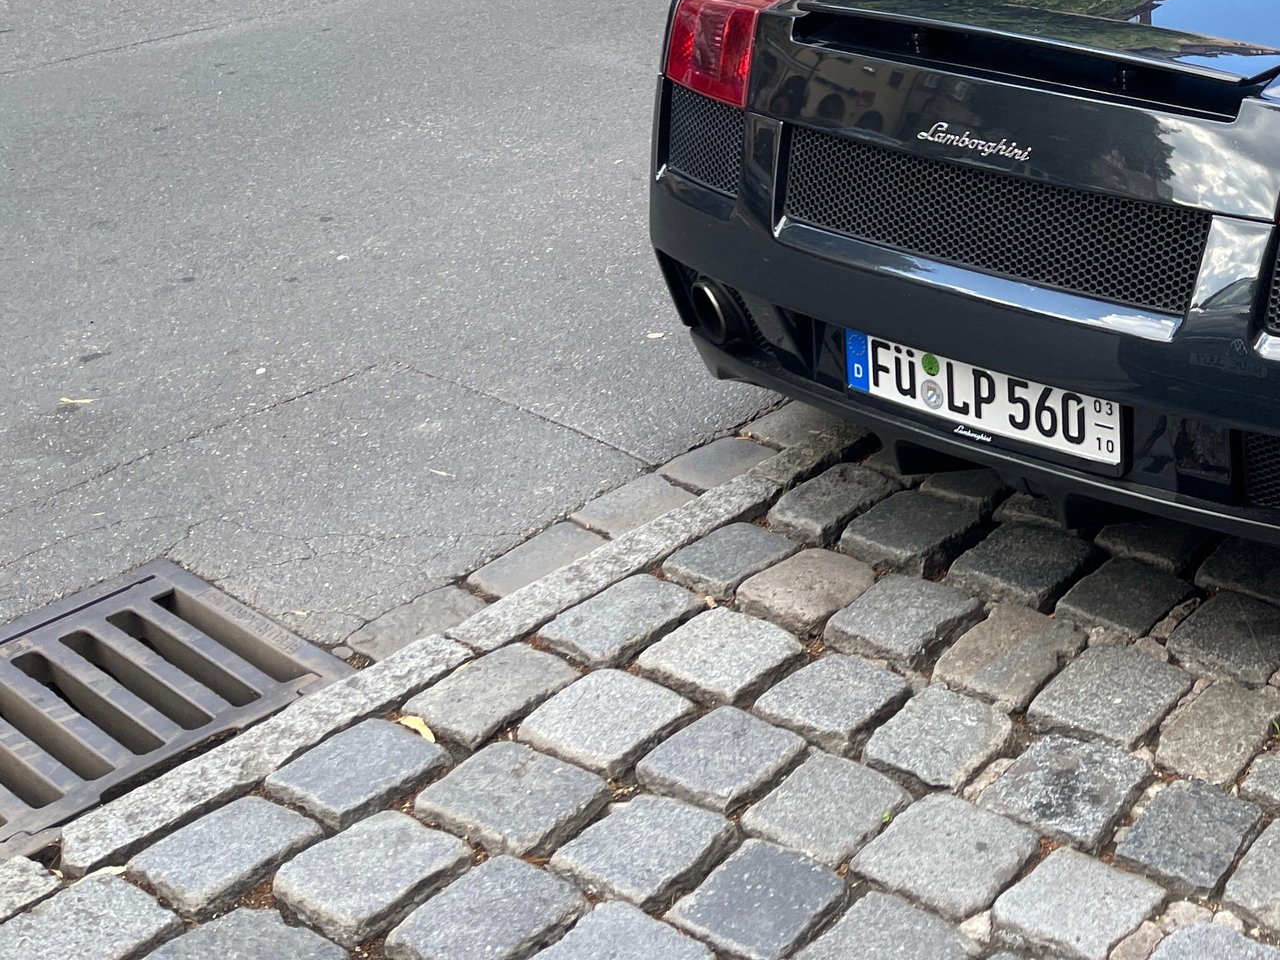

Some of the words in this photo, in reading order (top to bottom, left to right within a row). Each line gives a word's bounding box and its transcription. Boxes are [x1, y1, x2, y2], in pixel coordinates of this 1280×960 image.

[916, 121, 1032, 161] Lamborghini
[854, 363, 863, 379] D
[871, 339, 917, 400] FÜ
[946, 361, 996, 419] LP
[1007, 377, 1086, 445] 560
[1093, 399, 1113, 416] 03
[953, 425, 993, 443] Lamborghini
[1096, 437, 1114, 454] 10
